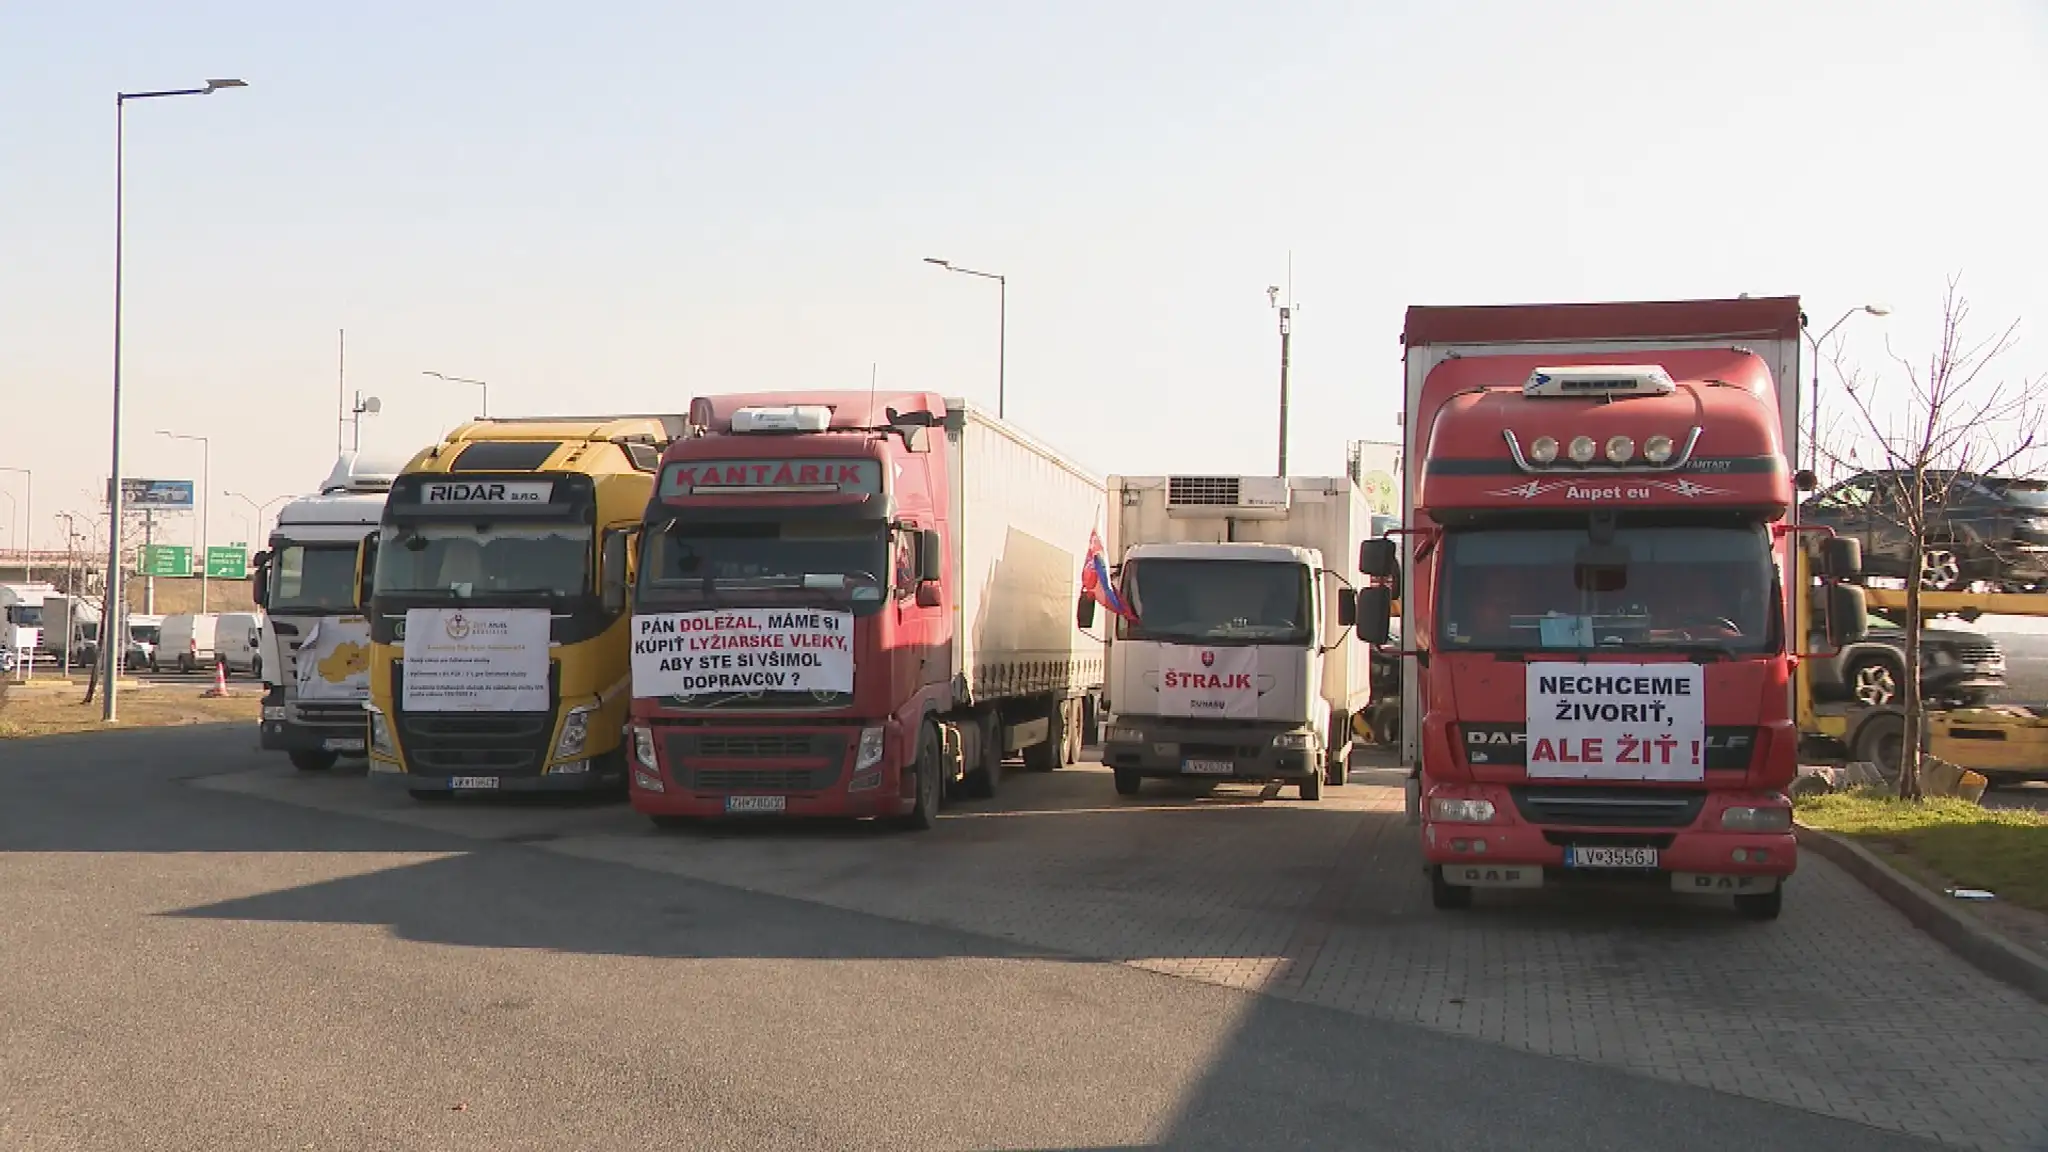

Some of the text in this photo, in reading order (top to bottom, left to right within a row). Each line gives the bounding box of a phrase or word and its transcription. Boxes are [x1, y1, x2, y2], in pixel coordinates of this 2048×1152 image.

[430, 484, 506, 501] RIDAR
[1566, 485, 1650, 501] Anpet eu
[641, 616, 674, 634] PÁN
[680, 613, 762, 633] DOLEŽAL,
[768, 613, 819, 630] MÁME
[635, 632, 848, 655] KÚPIŤ LYŽIARSKE VLEKY,
[659, 651, 822, 672] ABY STE SI VŠIMOL
[791, 672, 801, 687] ?
[1165, 668, 1252, 688] ŠTRAJK
[1539, 676, 1691, 696] NECHCEME
[1555, 700, 1674, 727] ŽIVORIŤ,
[1467, 731, 1528, 745] DAF
[1531, 733, 1700, 765] ALE ŽIŤ !
[1465, 869, 1520, 881] DAF
[1694, 875, 1754, 888] DAF
